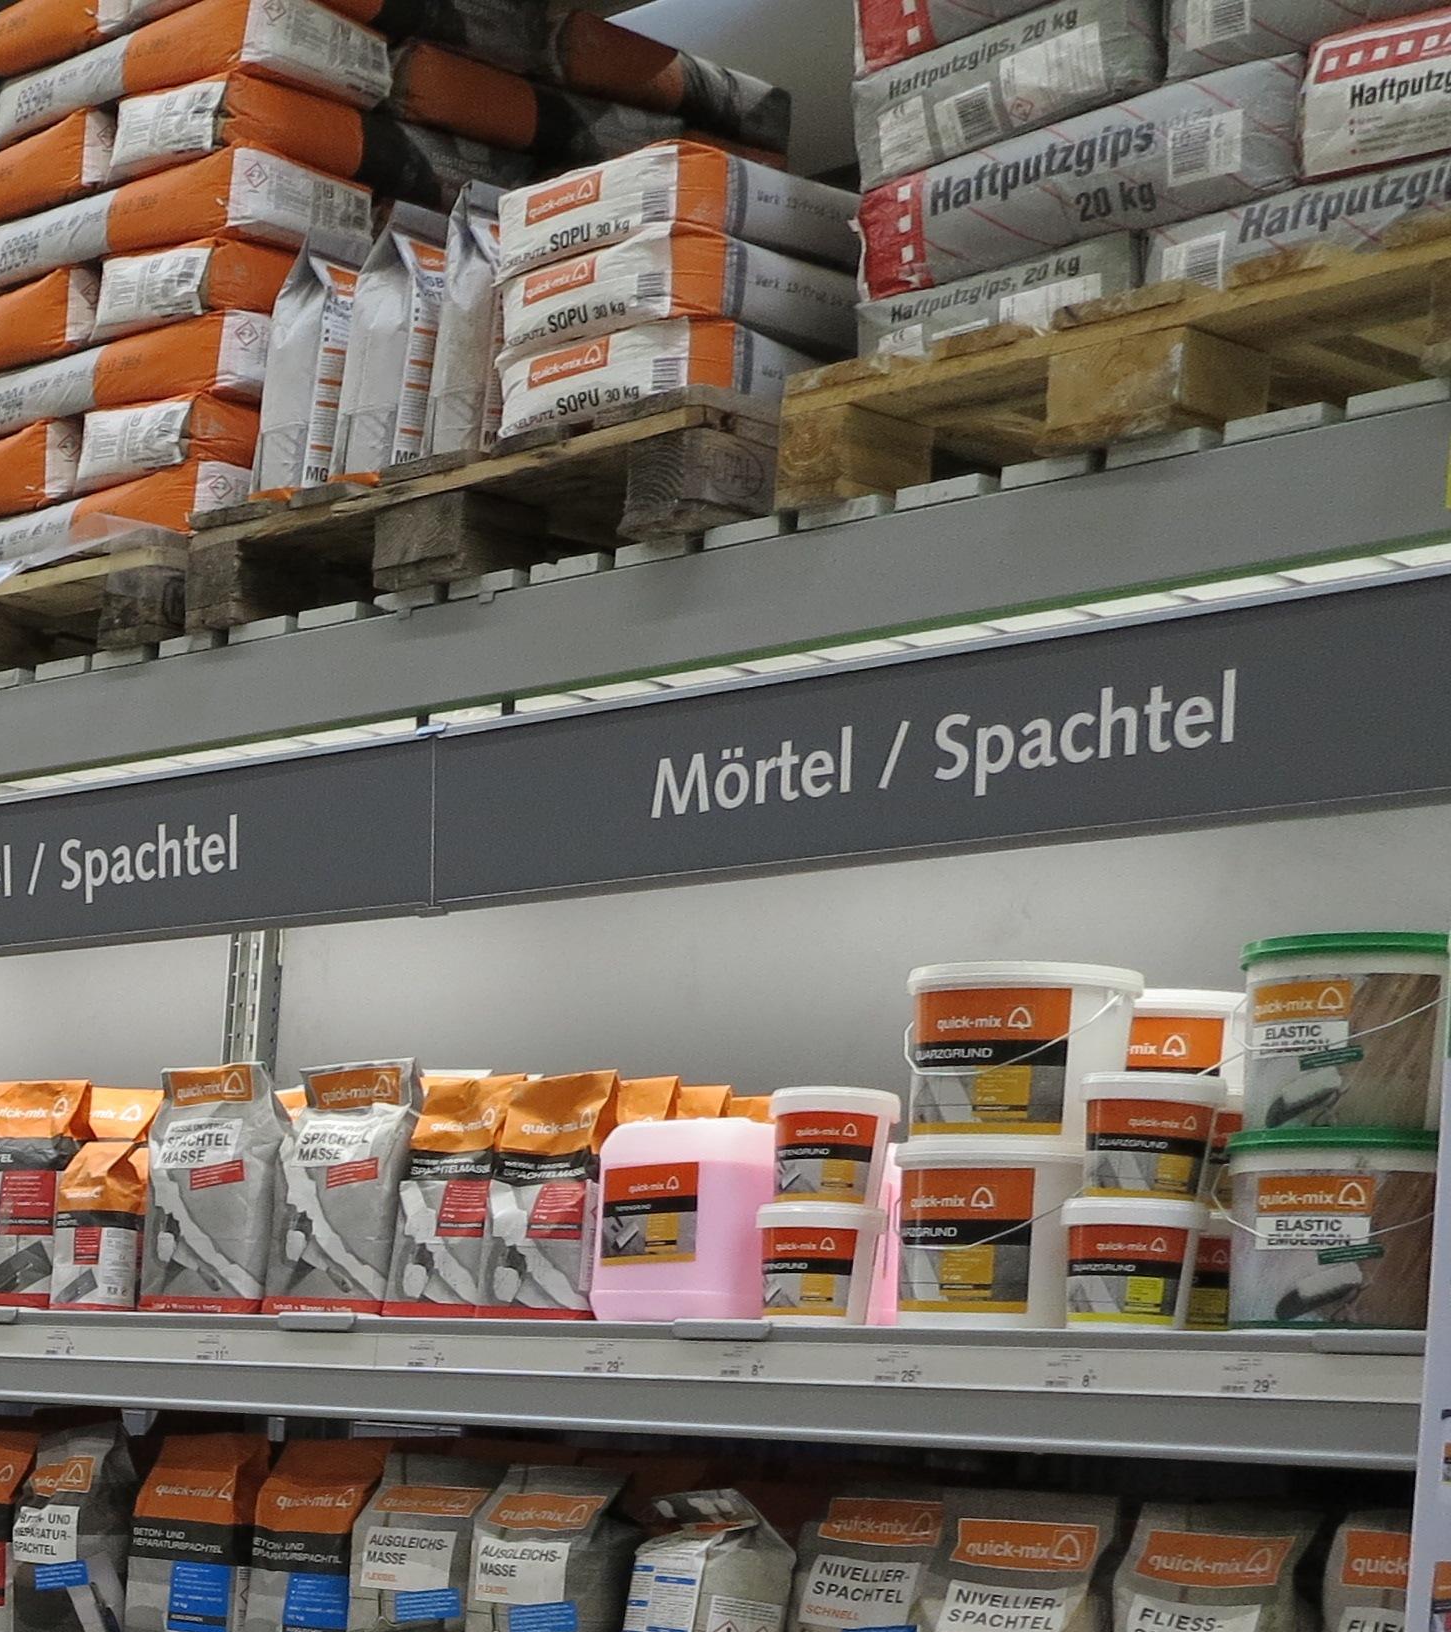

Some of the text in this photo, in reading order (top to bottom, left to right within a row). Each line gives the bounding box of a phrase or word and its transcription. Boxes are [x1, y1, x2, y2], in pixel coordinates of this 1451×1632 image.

[888, 8, 1079, 100] Haftputzgips, 20 kg
[929, 120, 1157, 218] Haftputzgips
[1075, 179, 1158, 224] 20 kg
[550, 218, 630, 252] SOPU 30 kg
[556, 384, 640, 416] SOPU 30 kg
[650, 668, 1240, 821] Mörtel / Spachtel
[27, 837, 49, 900] /
[59, 814, 241, 899] Spachtel
[936, 1014, 1002, 1034] quick-mix
[1265, 1025, 1323, 1040] ELASTIC
[176, 1082, 222, 1100] quick-mix
[1128, 1116, 1182, 1131] quick-mix
[166, 1133, 232, 1147] SPACHTEL
[161, 1149, 207, 1163] MASSE
[910, 1195, 966, 1211] quick-mix
[1257, 1190, 1334, 1212] quick-mix
[1274, 1218, 1342, 1234] ELASTIC
[368, 1533, 449, 1553] AUSGLEICHS-
[966, 1541, 1049, 1561] quick-mix
[365, 1550, 408, 1566] MASSE
[1148, 1554, 1245, 1575] quick-mix
[819, 1561, 911, 1584] NIVELLIER-
[811, 1580, 905, 1604] SPACHTEL
[955, 1588, 1063, 1610] NIVELLIER-
[947, 1609, 1055, 1631] SPACHTEL
[1138, 1608, 1224, 1632] FLIESS-
